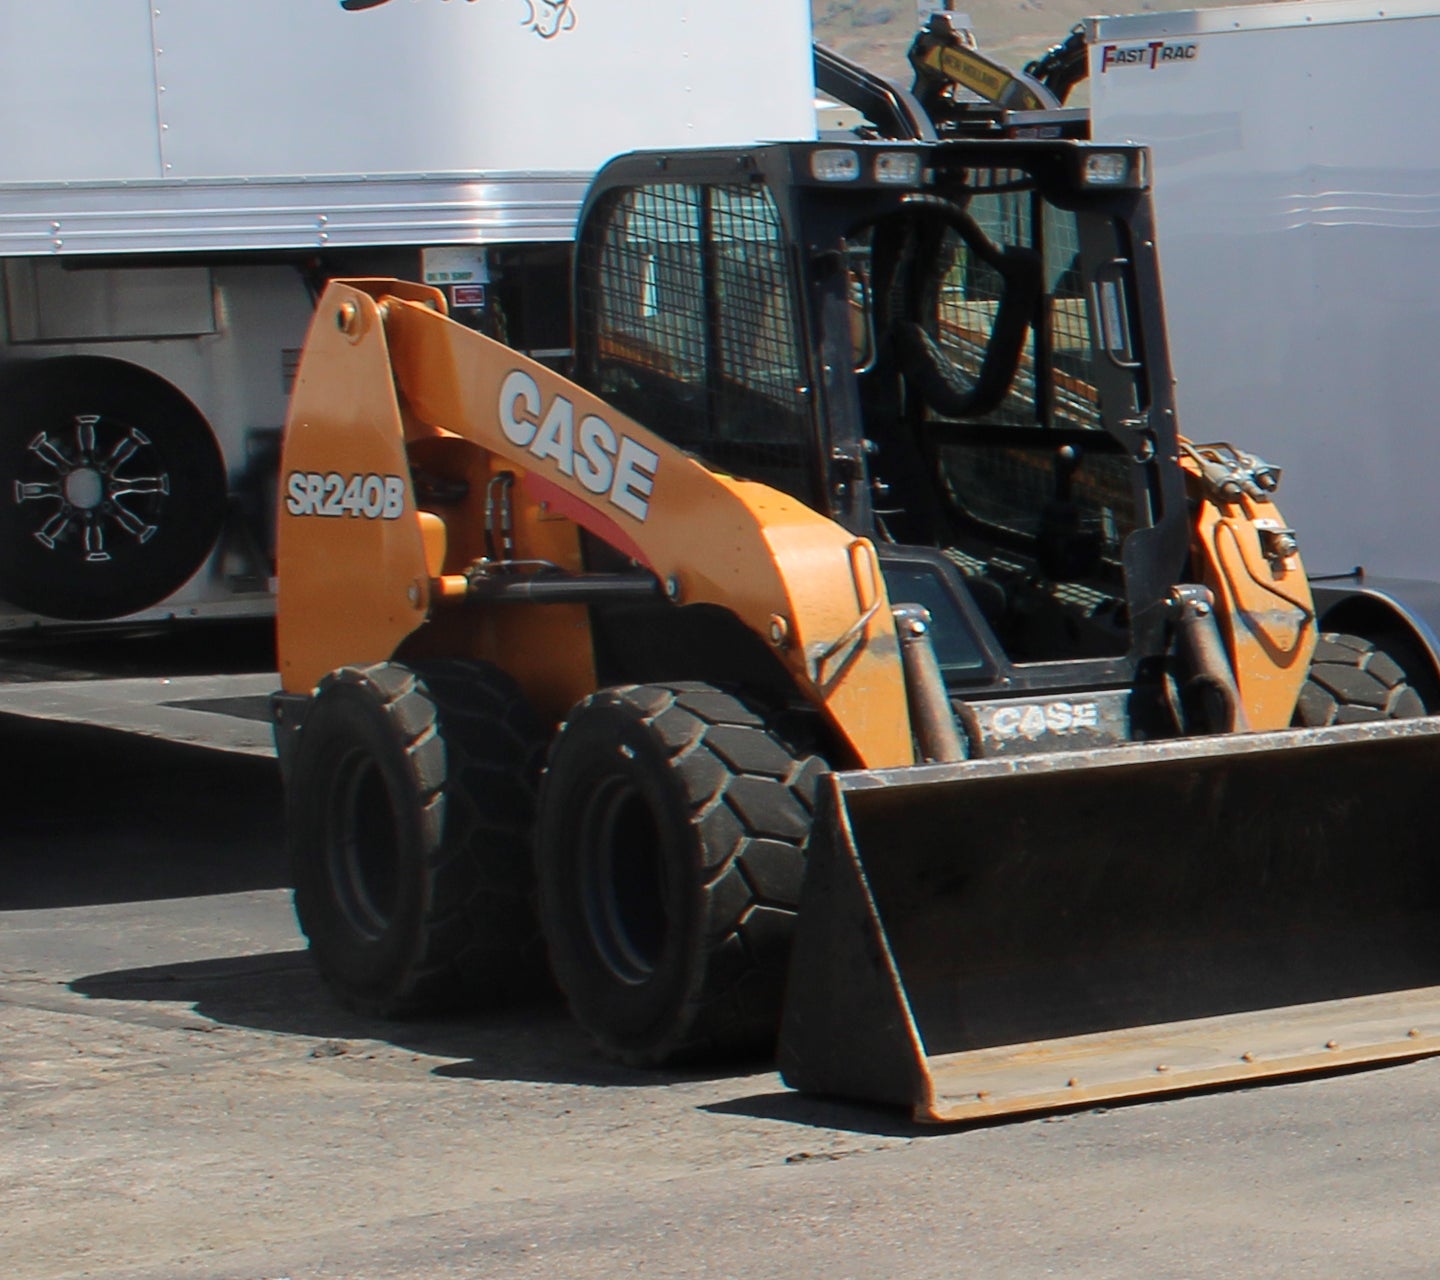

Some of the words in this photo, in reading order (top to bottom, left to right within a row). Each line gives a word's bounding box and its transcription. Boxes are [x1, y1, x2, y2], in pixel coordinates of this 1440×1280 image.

[498, 369, 661, 523] CASE
[285, 471, 405, 520] SR240B
[991, 701, 1100, 736] CASE
